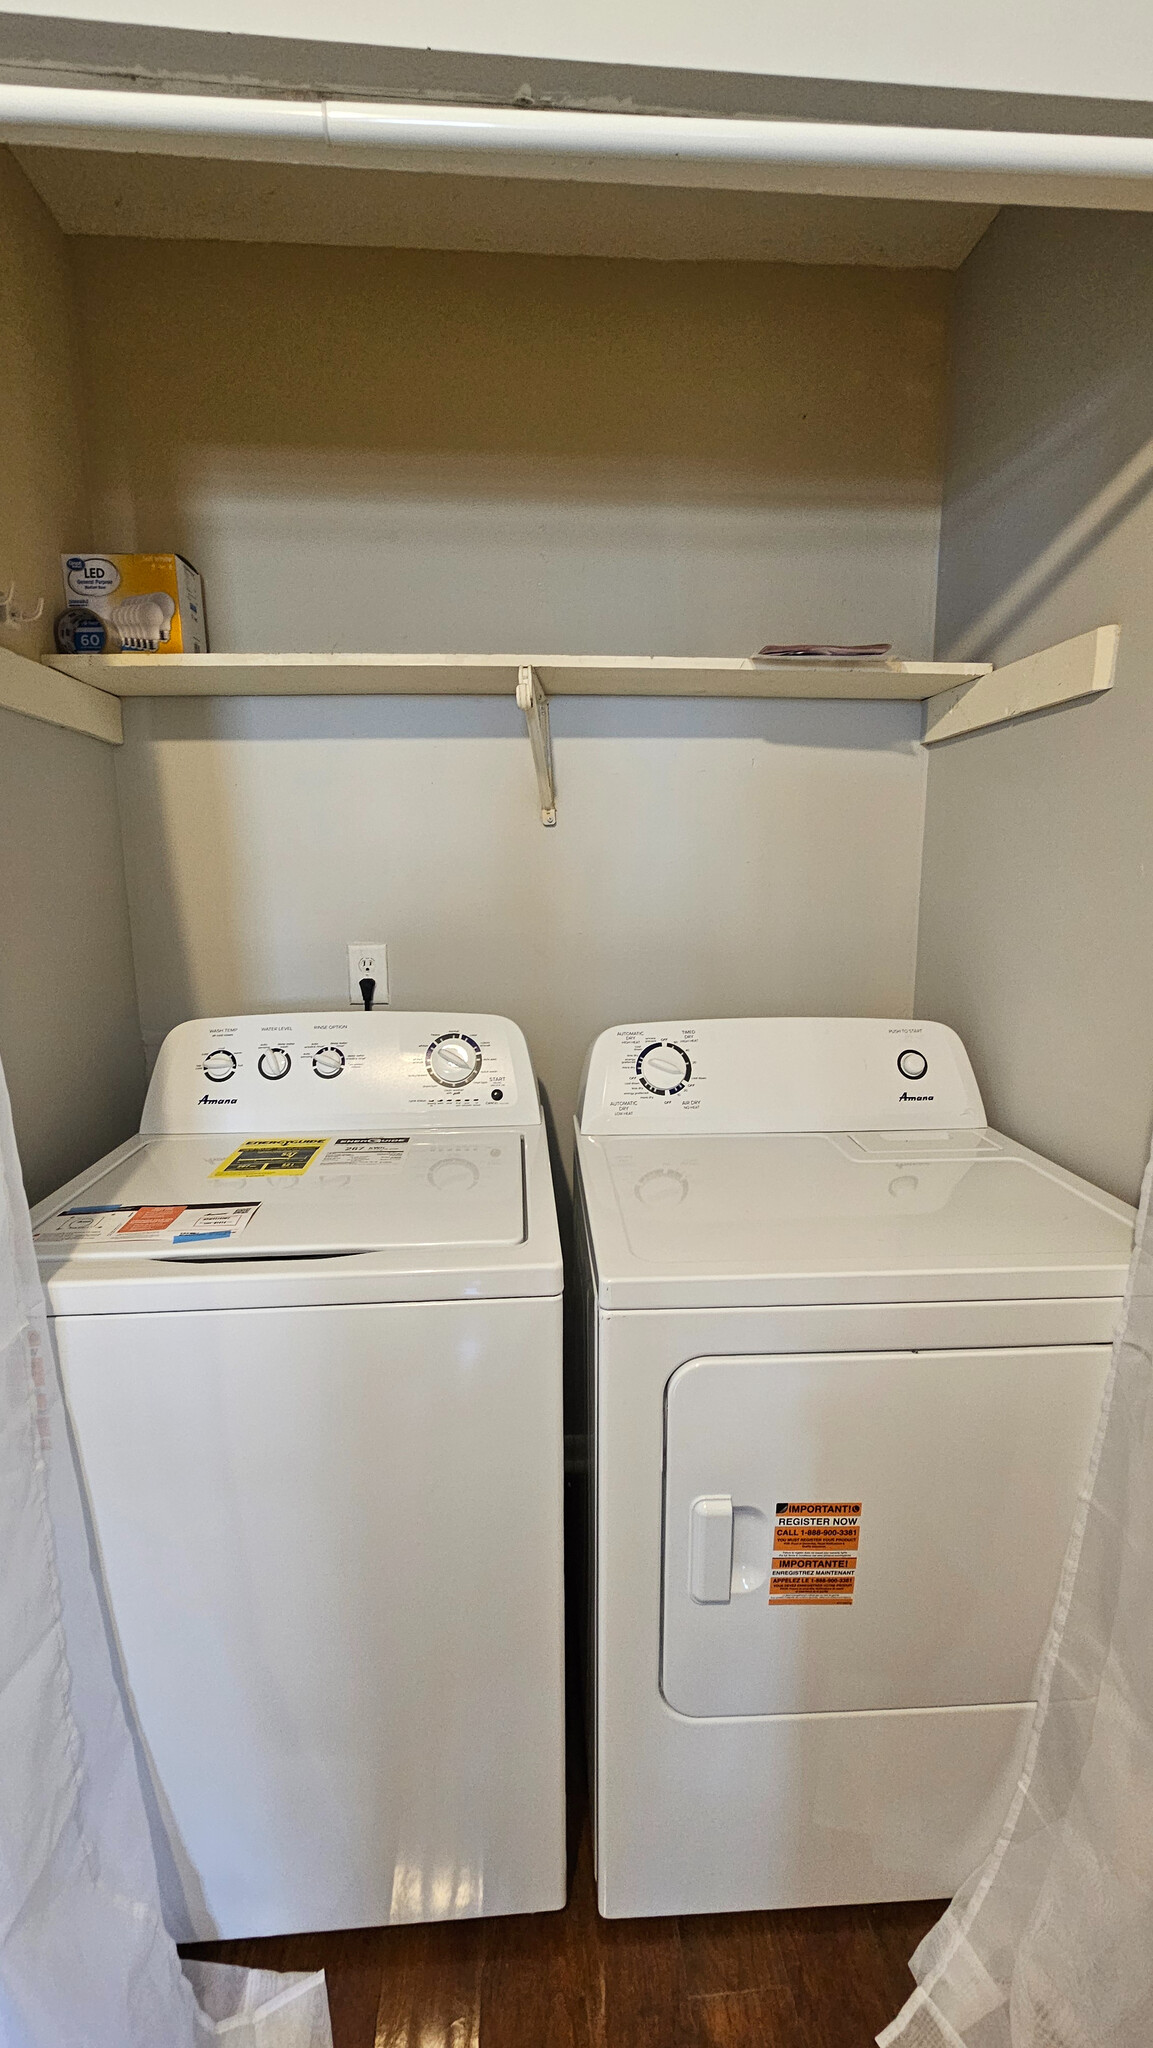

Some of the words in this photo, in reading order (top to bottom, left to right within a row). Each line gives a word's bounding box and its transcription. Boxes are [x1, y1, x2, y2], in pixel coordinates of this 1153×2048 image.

[84, 568, 105, 578] LED
[80, 634, 100, 646] 60
[198, 1095, 238, 1105] Amana
[899, 1092, 934, 1102] Amana
[789, 1505, 851, 1513] IMPORTANT!
